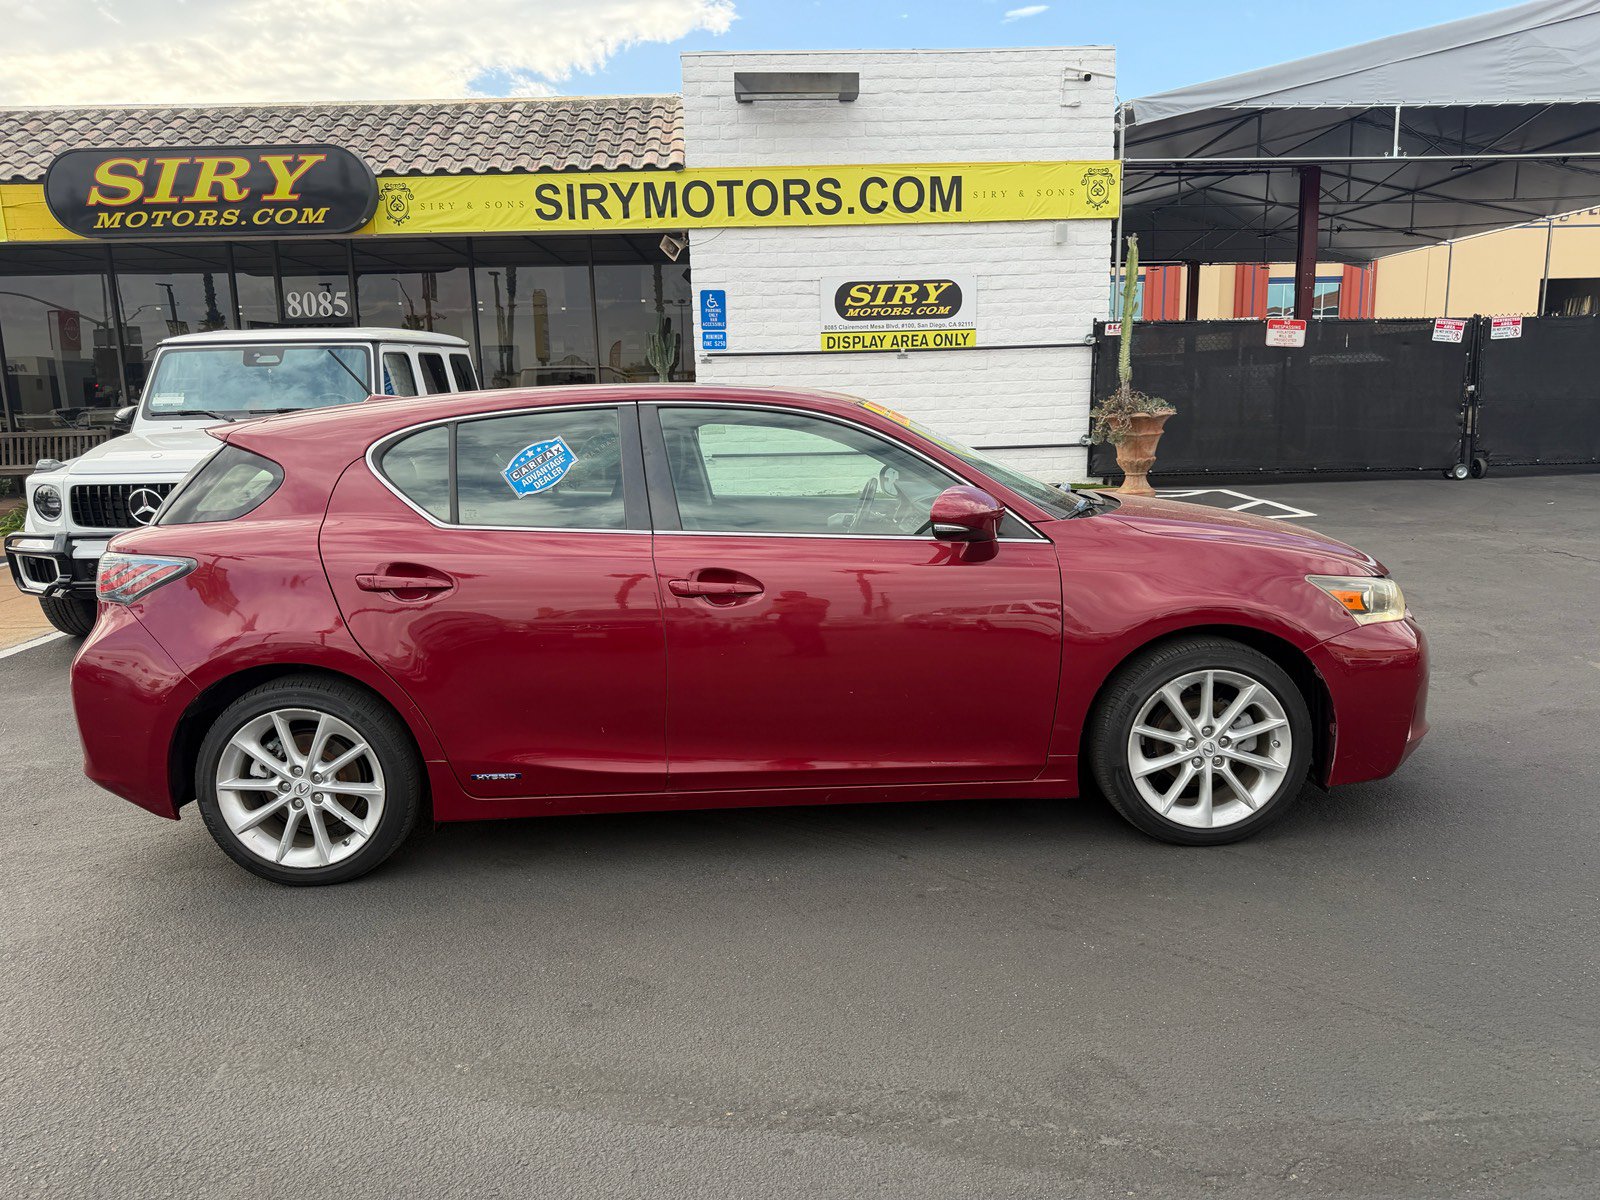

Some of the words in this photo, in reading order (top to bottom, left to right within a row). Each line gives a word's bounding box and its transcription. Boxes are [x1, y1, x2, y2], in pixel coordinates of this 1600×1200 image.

[86, 154, 326, 206] SIRY
[534, 175, 963, 221] SIRYMOTORS.COM
[972, 189, 1008, 199] SIRY
[1018, 189, 1025, 197] &
[1036, 188, 1077, 197] SONS
[420, 201, 456, 211] SIRY
[466, 201, 474, 210] &
[484, 200, 526, 210] SONS
[93, 207, 330, 229] MOTORS.COM
[287, 291, 349, 317] 8085
[845, 283, 952, 306] SIRY
[845, 306, 952, 317] MOTORS.COM
[838, 323, 869, 331] Clairemont
[826, 334, 887, 350] DISPLAY
[890, 333, 929, 348] AREA
[933, 332, 970, 347] ONLY
[511, 446, 563, 480] CARFAX
[521, 456, 566, 487] ADVANTAGE
[533, 467, 564, 489] DEALER
